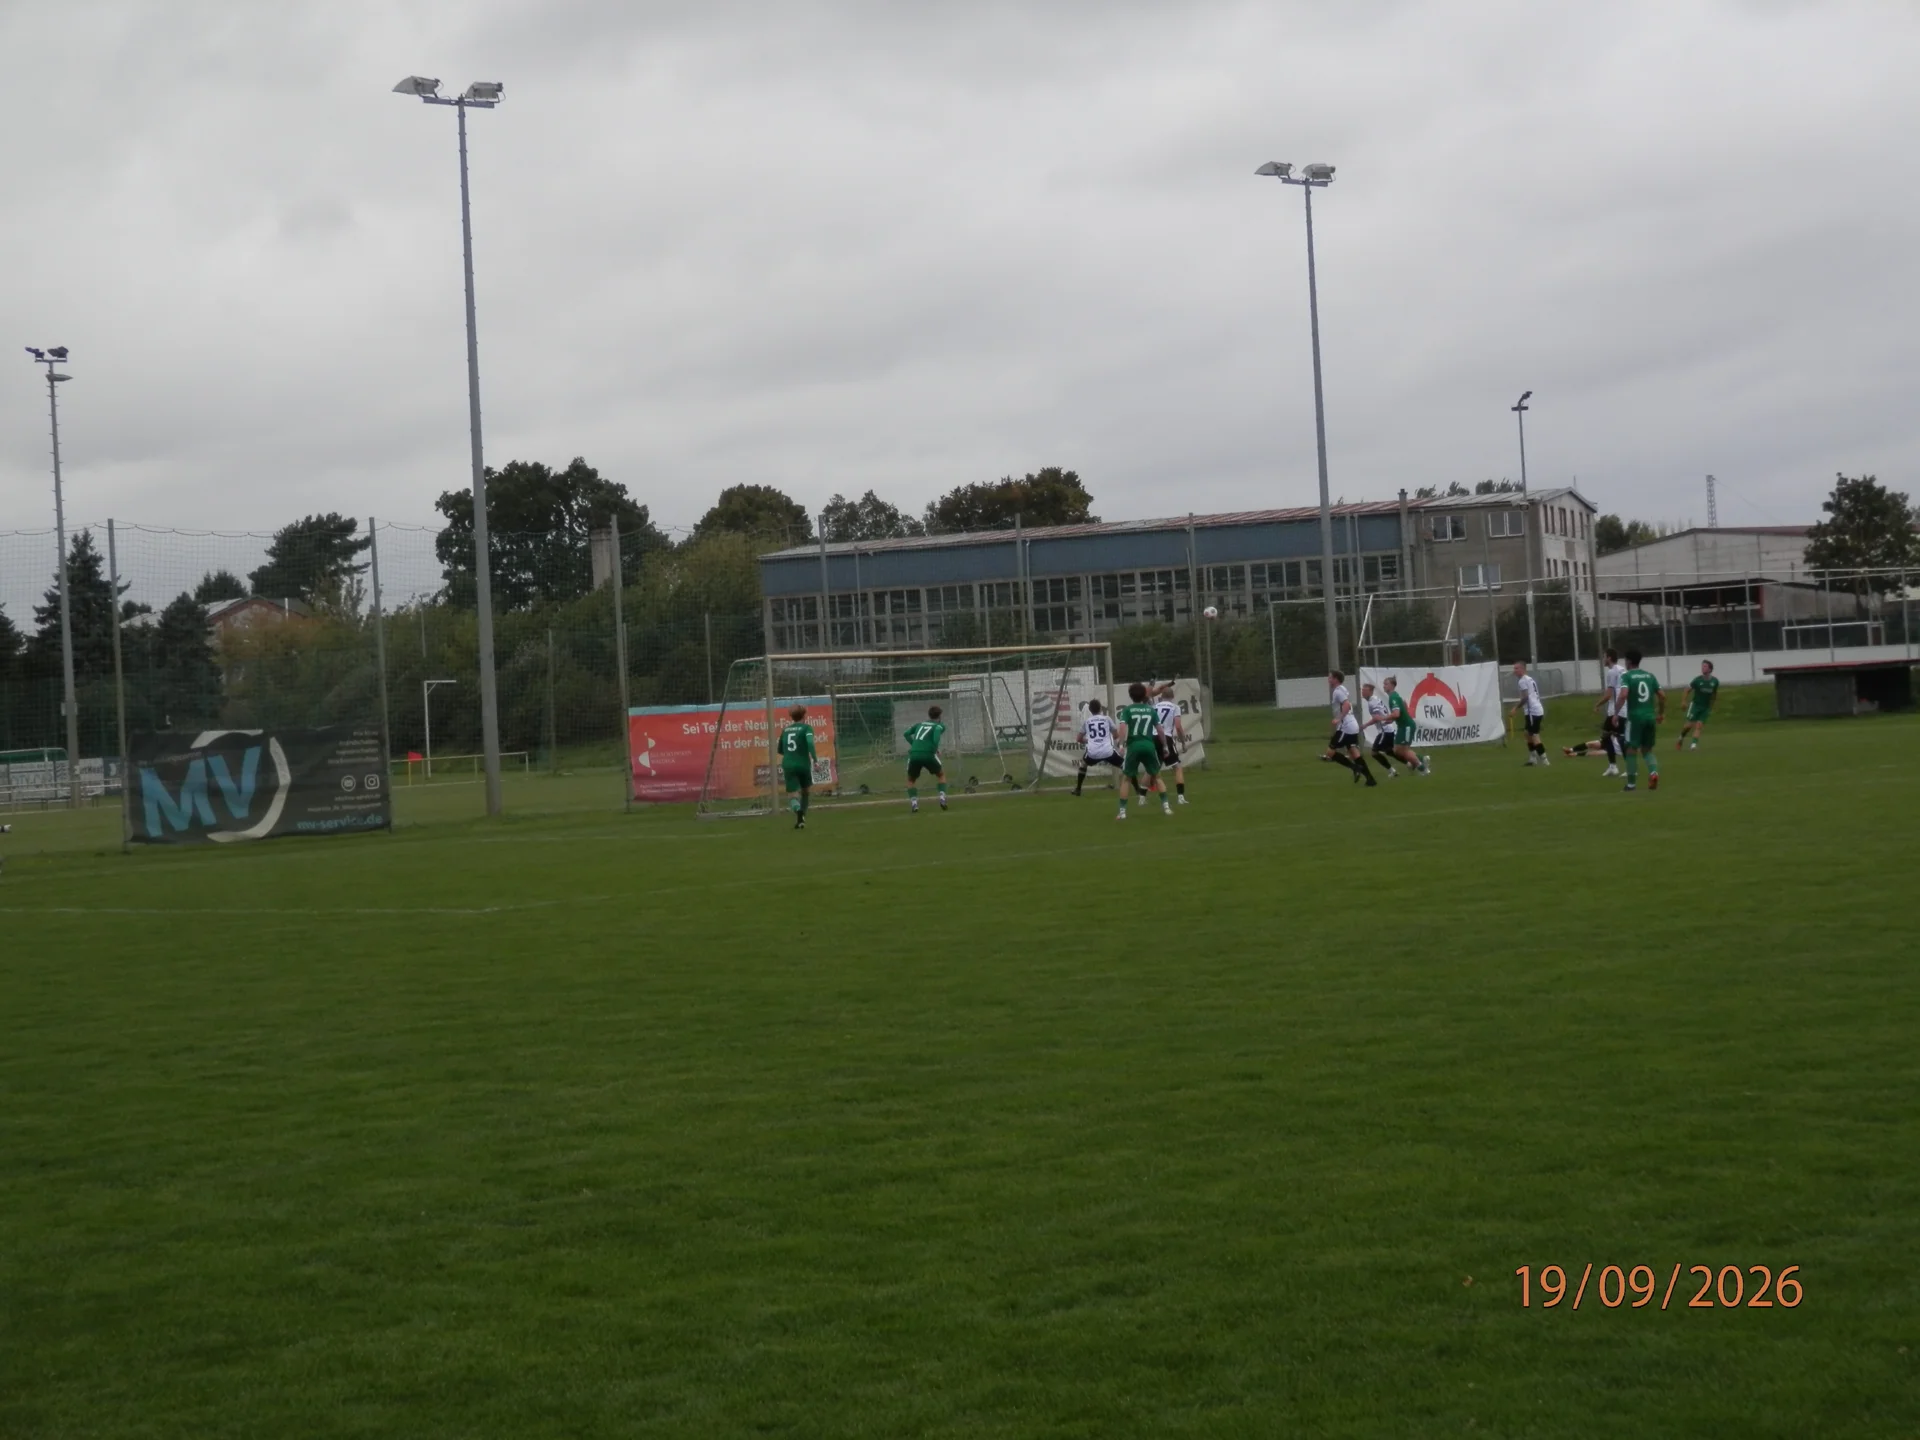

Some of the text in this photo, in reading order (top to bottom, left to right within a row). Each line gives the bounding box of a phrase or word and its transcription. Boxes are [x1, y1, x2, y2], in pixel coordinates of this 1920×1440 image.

[1638, 681, 1650, 703] 9
[1423, 704, 1445, 719] FMK
[682, 722, 700, 735] Sei
[724, 719, 743, 733] der
[915, 725, 933, 741] 17
[1088, 722, 1106, 739] 55
[1131, 714, 1152, 736] 77
[721, 738, 731, 749] in
[734, 736, 752, 749] der
[787, 733, 797, 752] 5
[139, 746, 262, 838] MV
